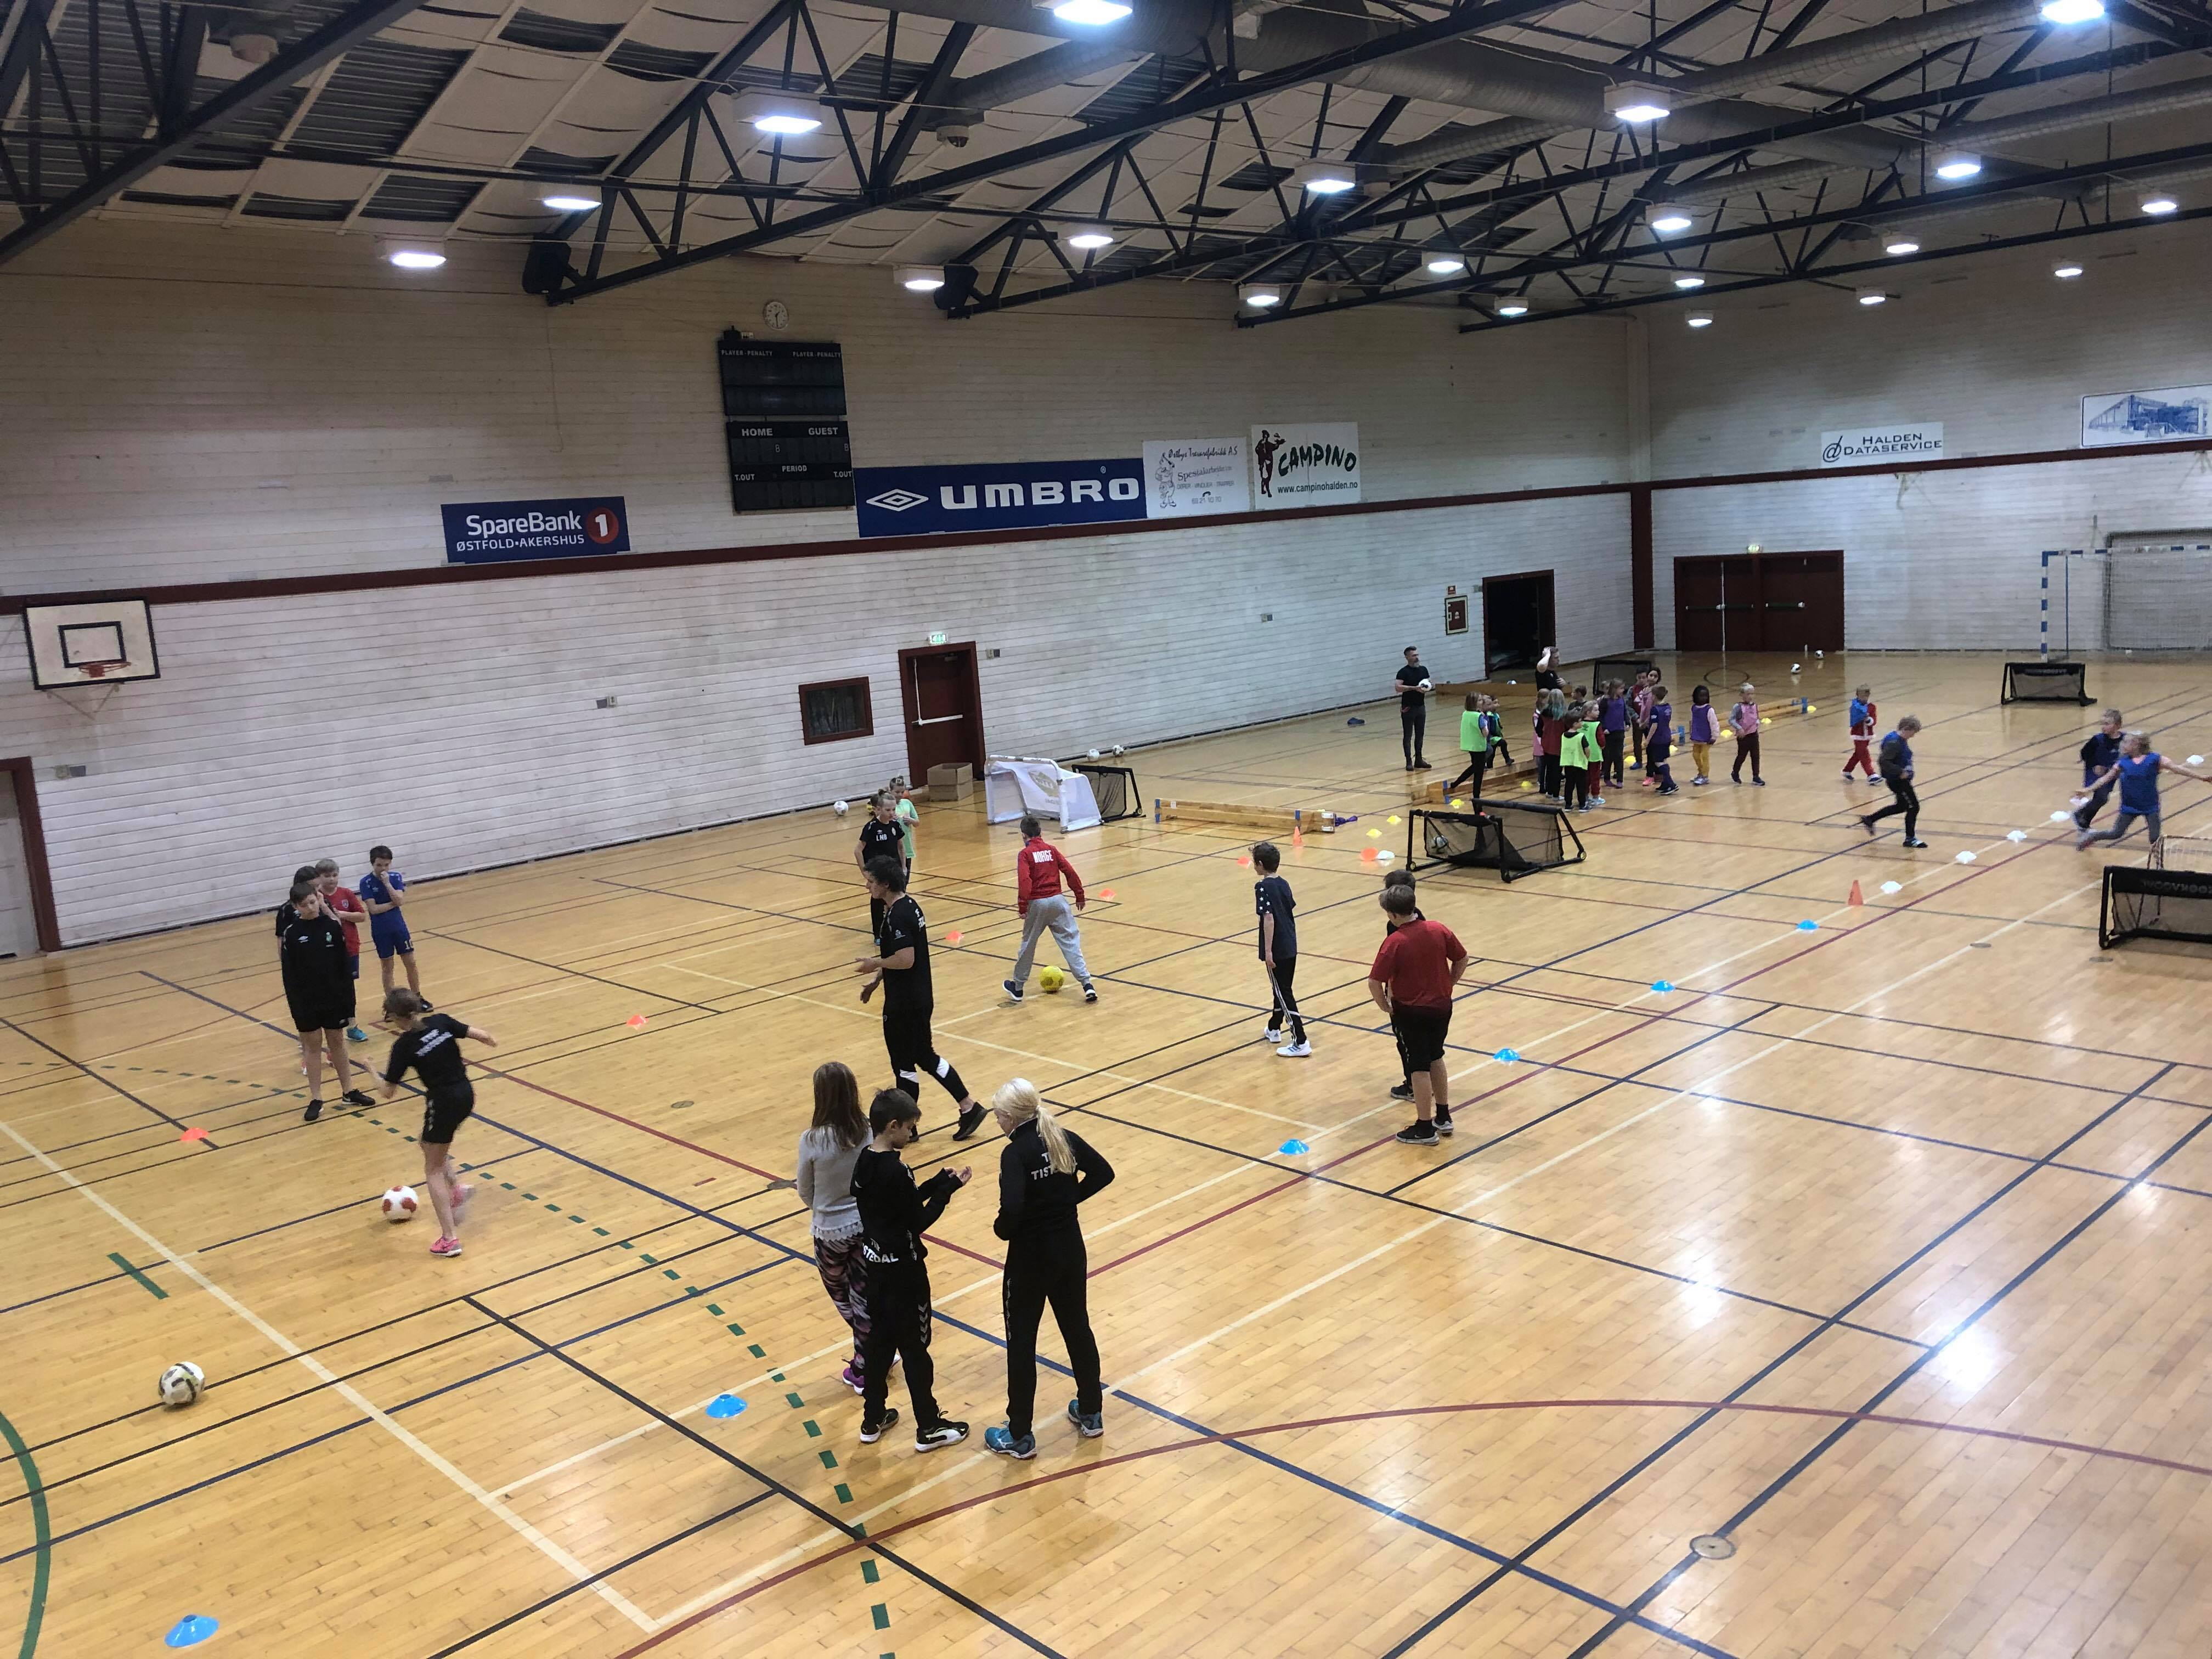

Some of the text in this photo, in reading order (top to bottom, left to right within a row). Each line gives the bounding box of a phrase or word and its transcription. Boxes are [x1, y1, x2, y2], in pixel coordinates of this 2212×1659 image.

[741, 427, 773, 437] HOME
[808, 427, 838, 436] GUEST
[1863, 432, 1922, 445] HALDEN
[1844, 440, 1943, 456] DATASERVICE
[1278, 443, 1357, 476] CAMPINO
[940, 478, 1139, 509] UMBRO
[1278, 481, 1358, 493] www.campinohalden.no
[466, 511, 582, 538] SpareBank
[1032, 850, 1054, 863] NORGE
[862, 1242, 899, 1263] STEDAL
